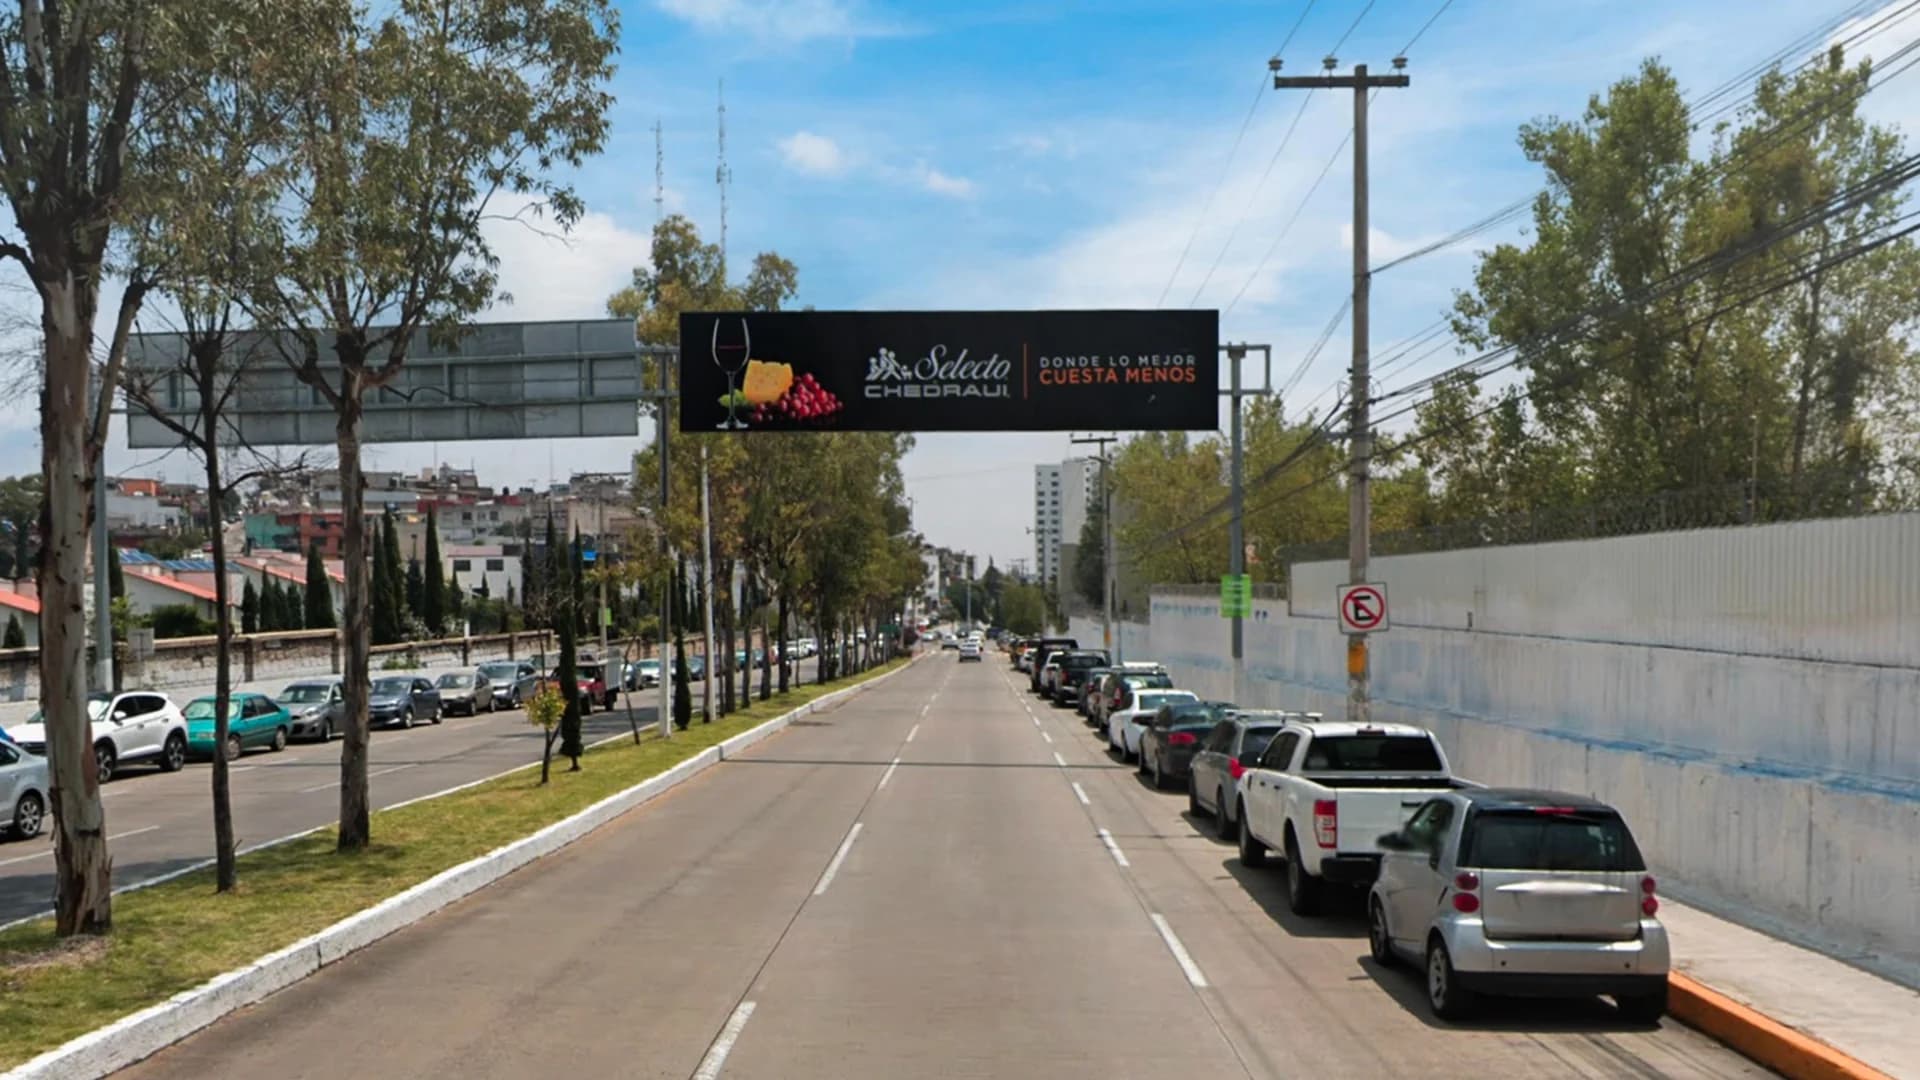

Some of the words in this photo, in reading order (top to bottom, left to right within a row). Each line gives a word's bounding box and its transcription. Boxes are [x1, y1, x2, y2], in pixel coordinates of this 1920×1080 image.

[914, 344, 1011, 380] Selecto
[1039, 356, 1100, 368] DONDE
[1109, 355, 1130, 367] LO
[1138, 355, 1196, 366] MEJOR
[1039, 367, 1118, 384] CUESTA
[1125, 366, 1196, 383] MENOS
[864, 384, 1009, 397] CHEDRAUI
